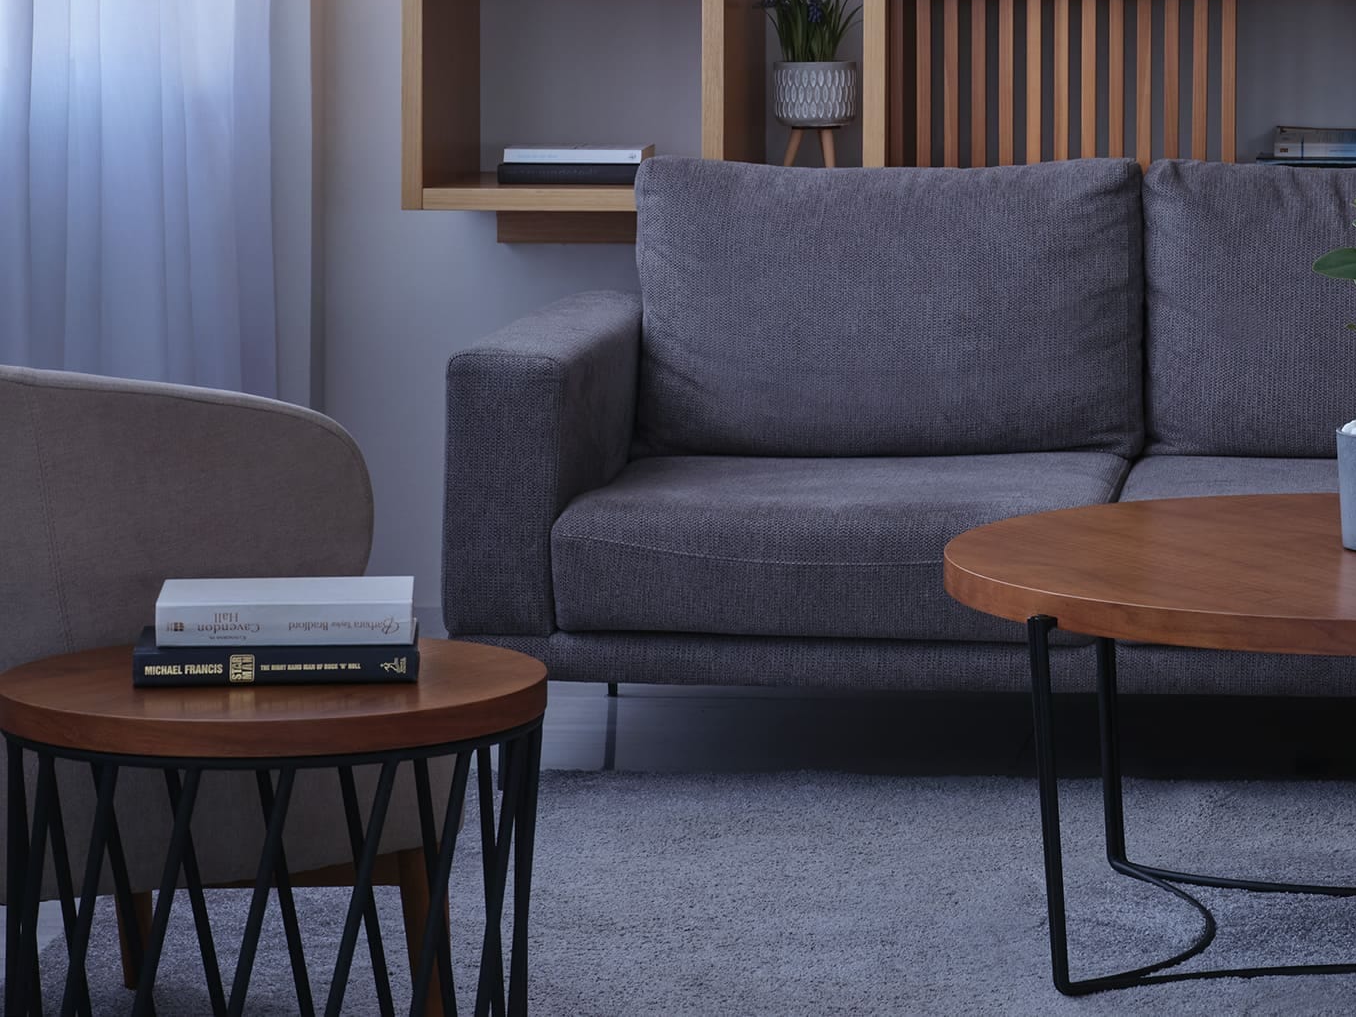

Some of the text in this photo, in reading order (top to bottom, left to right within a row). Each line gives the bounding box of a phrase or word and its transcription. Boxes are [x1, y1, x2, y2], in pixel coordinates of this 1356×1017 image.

[214, 611, 240, 623] Hall
[197, 622, 261, 633] Cavendon
[288, 621, 329, 632] Bradford
[353, 616, 400, 634] Barbara
[144, 663, 223, 676] MICHAEL FRANCIS
[231, 656, 242, 680] STAR
